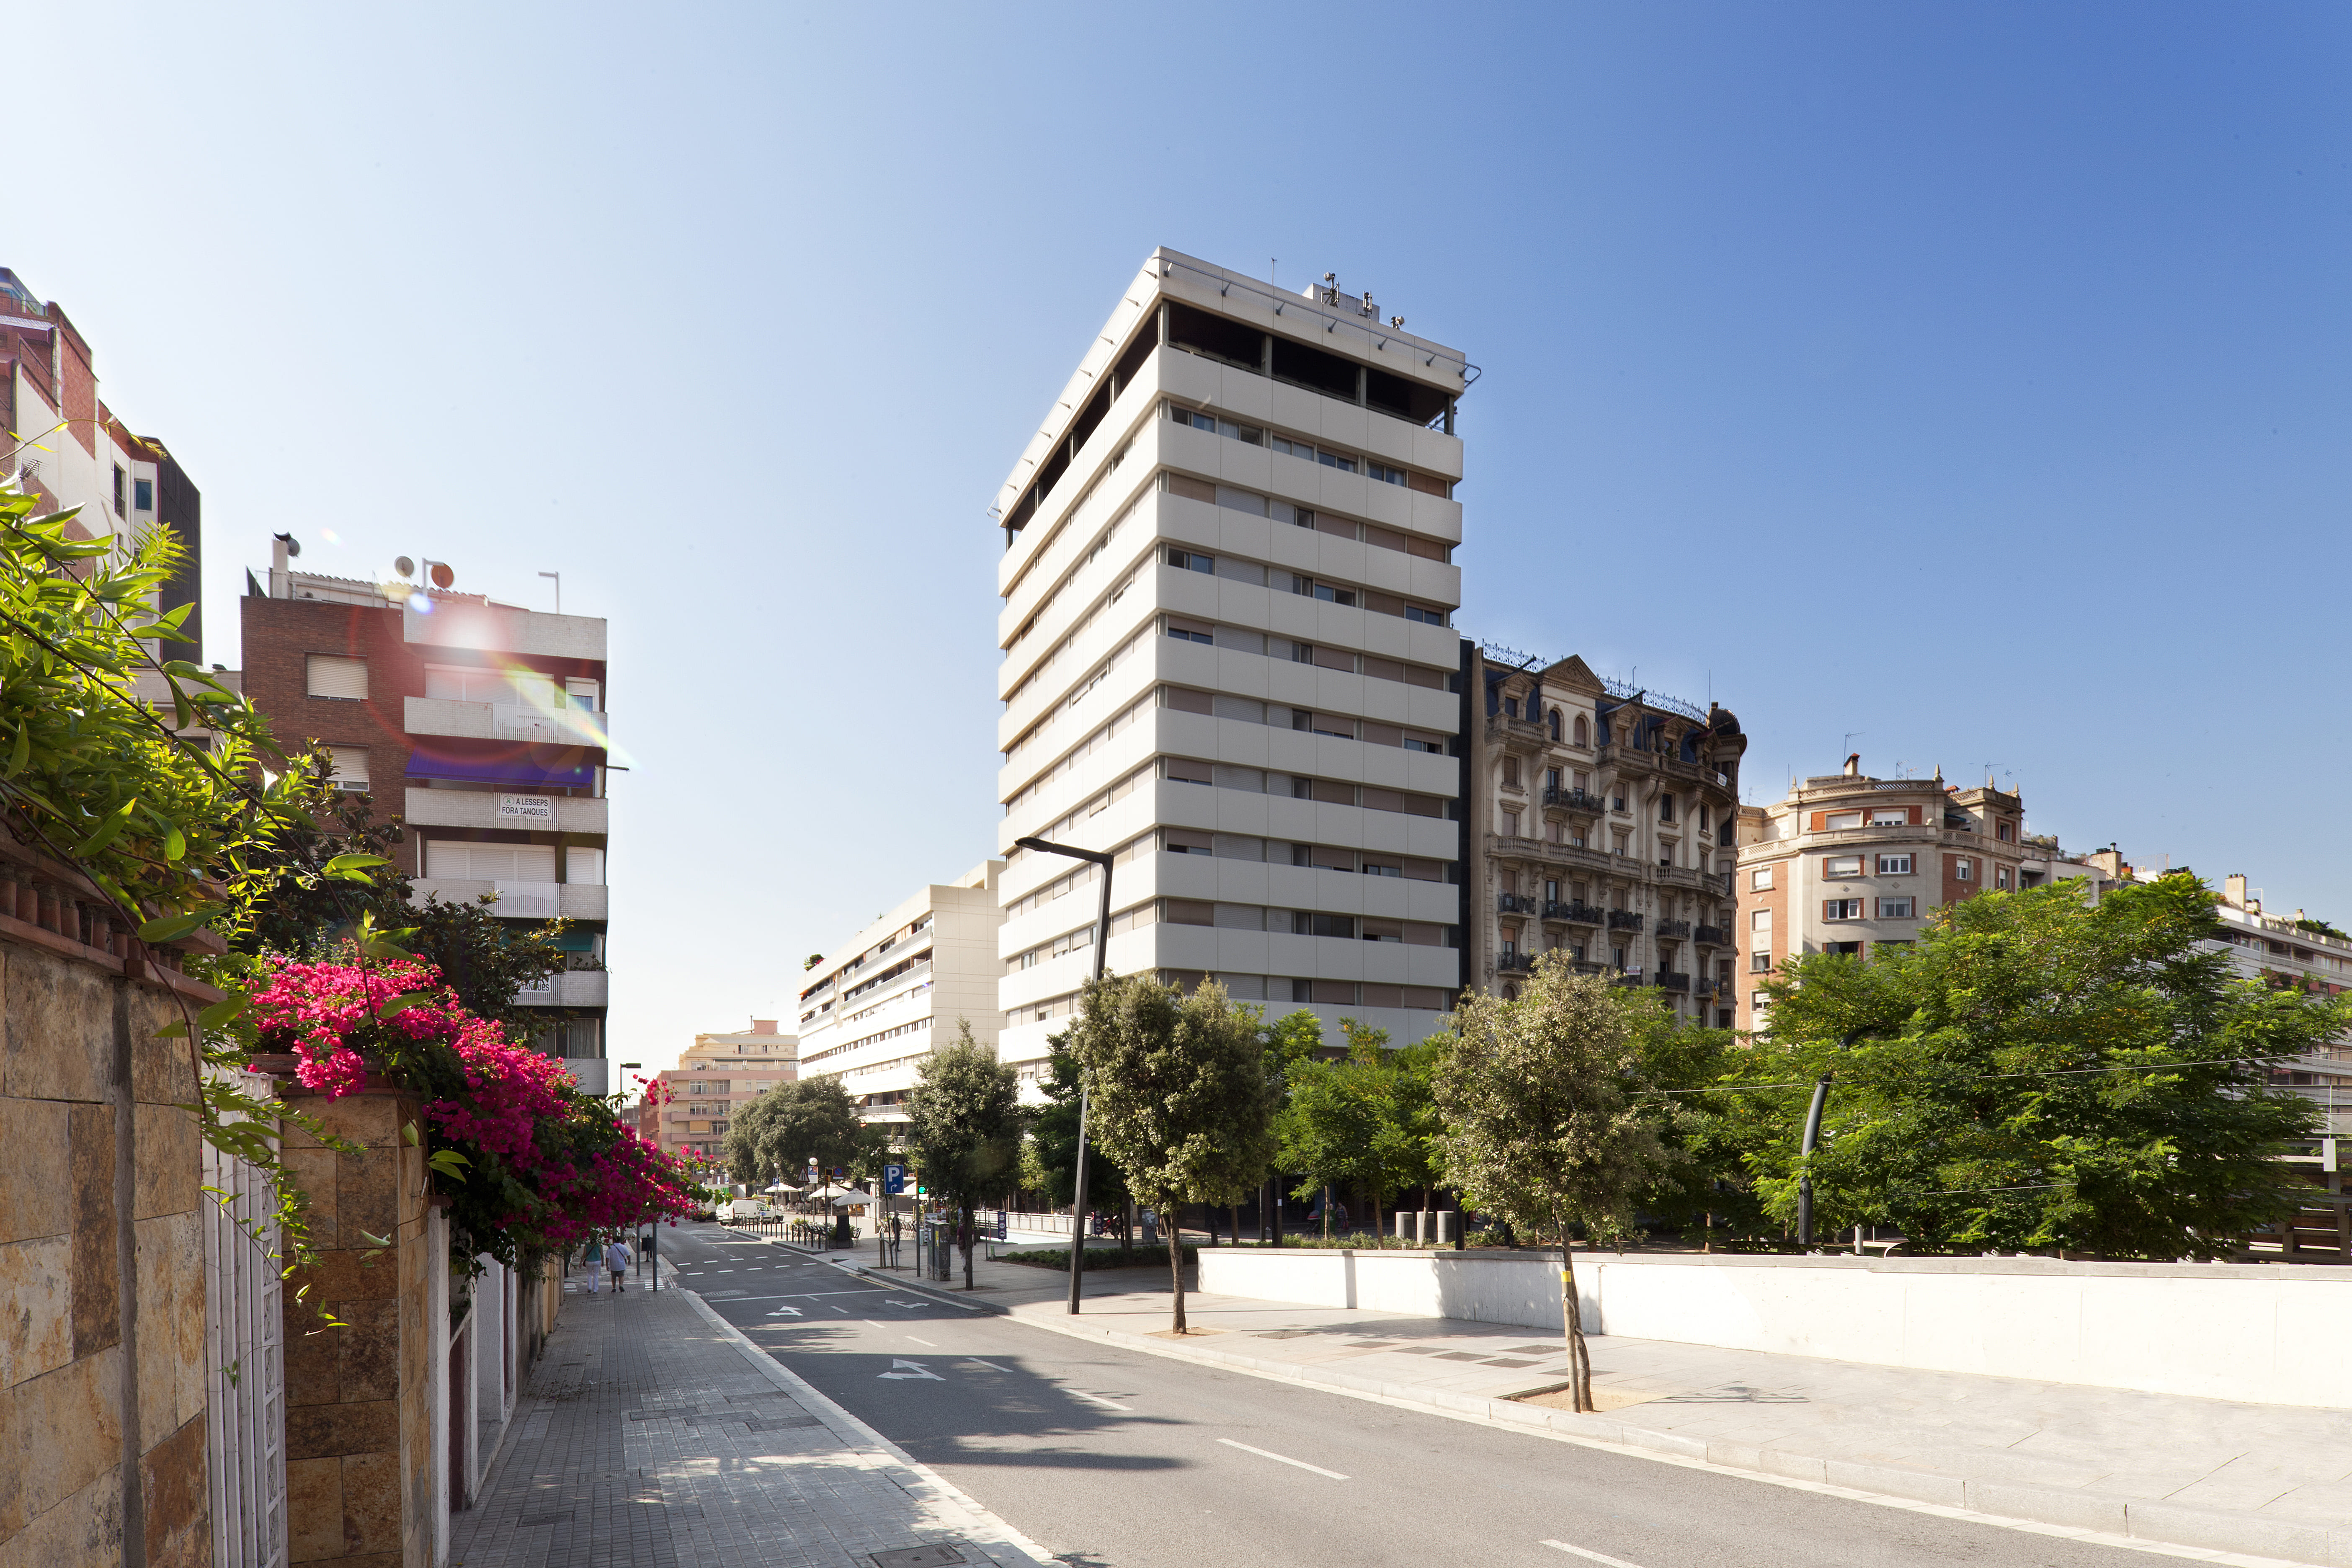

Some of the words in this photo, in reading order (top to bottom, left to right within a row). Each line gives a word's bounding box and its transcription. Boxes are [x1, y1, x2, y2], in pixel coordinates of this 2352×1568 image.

[522, 798, 548, 807] LESSEPS
[520, 807, 548, 816] TANQUES
[888, 1167, 900, 1182] P
